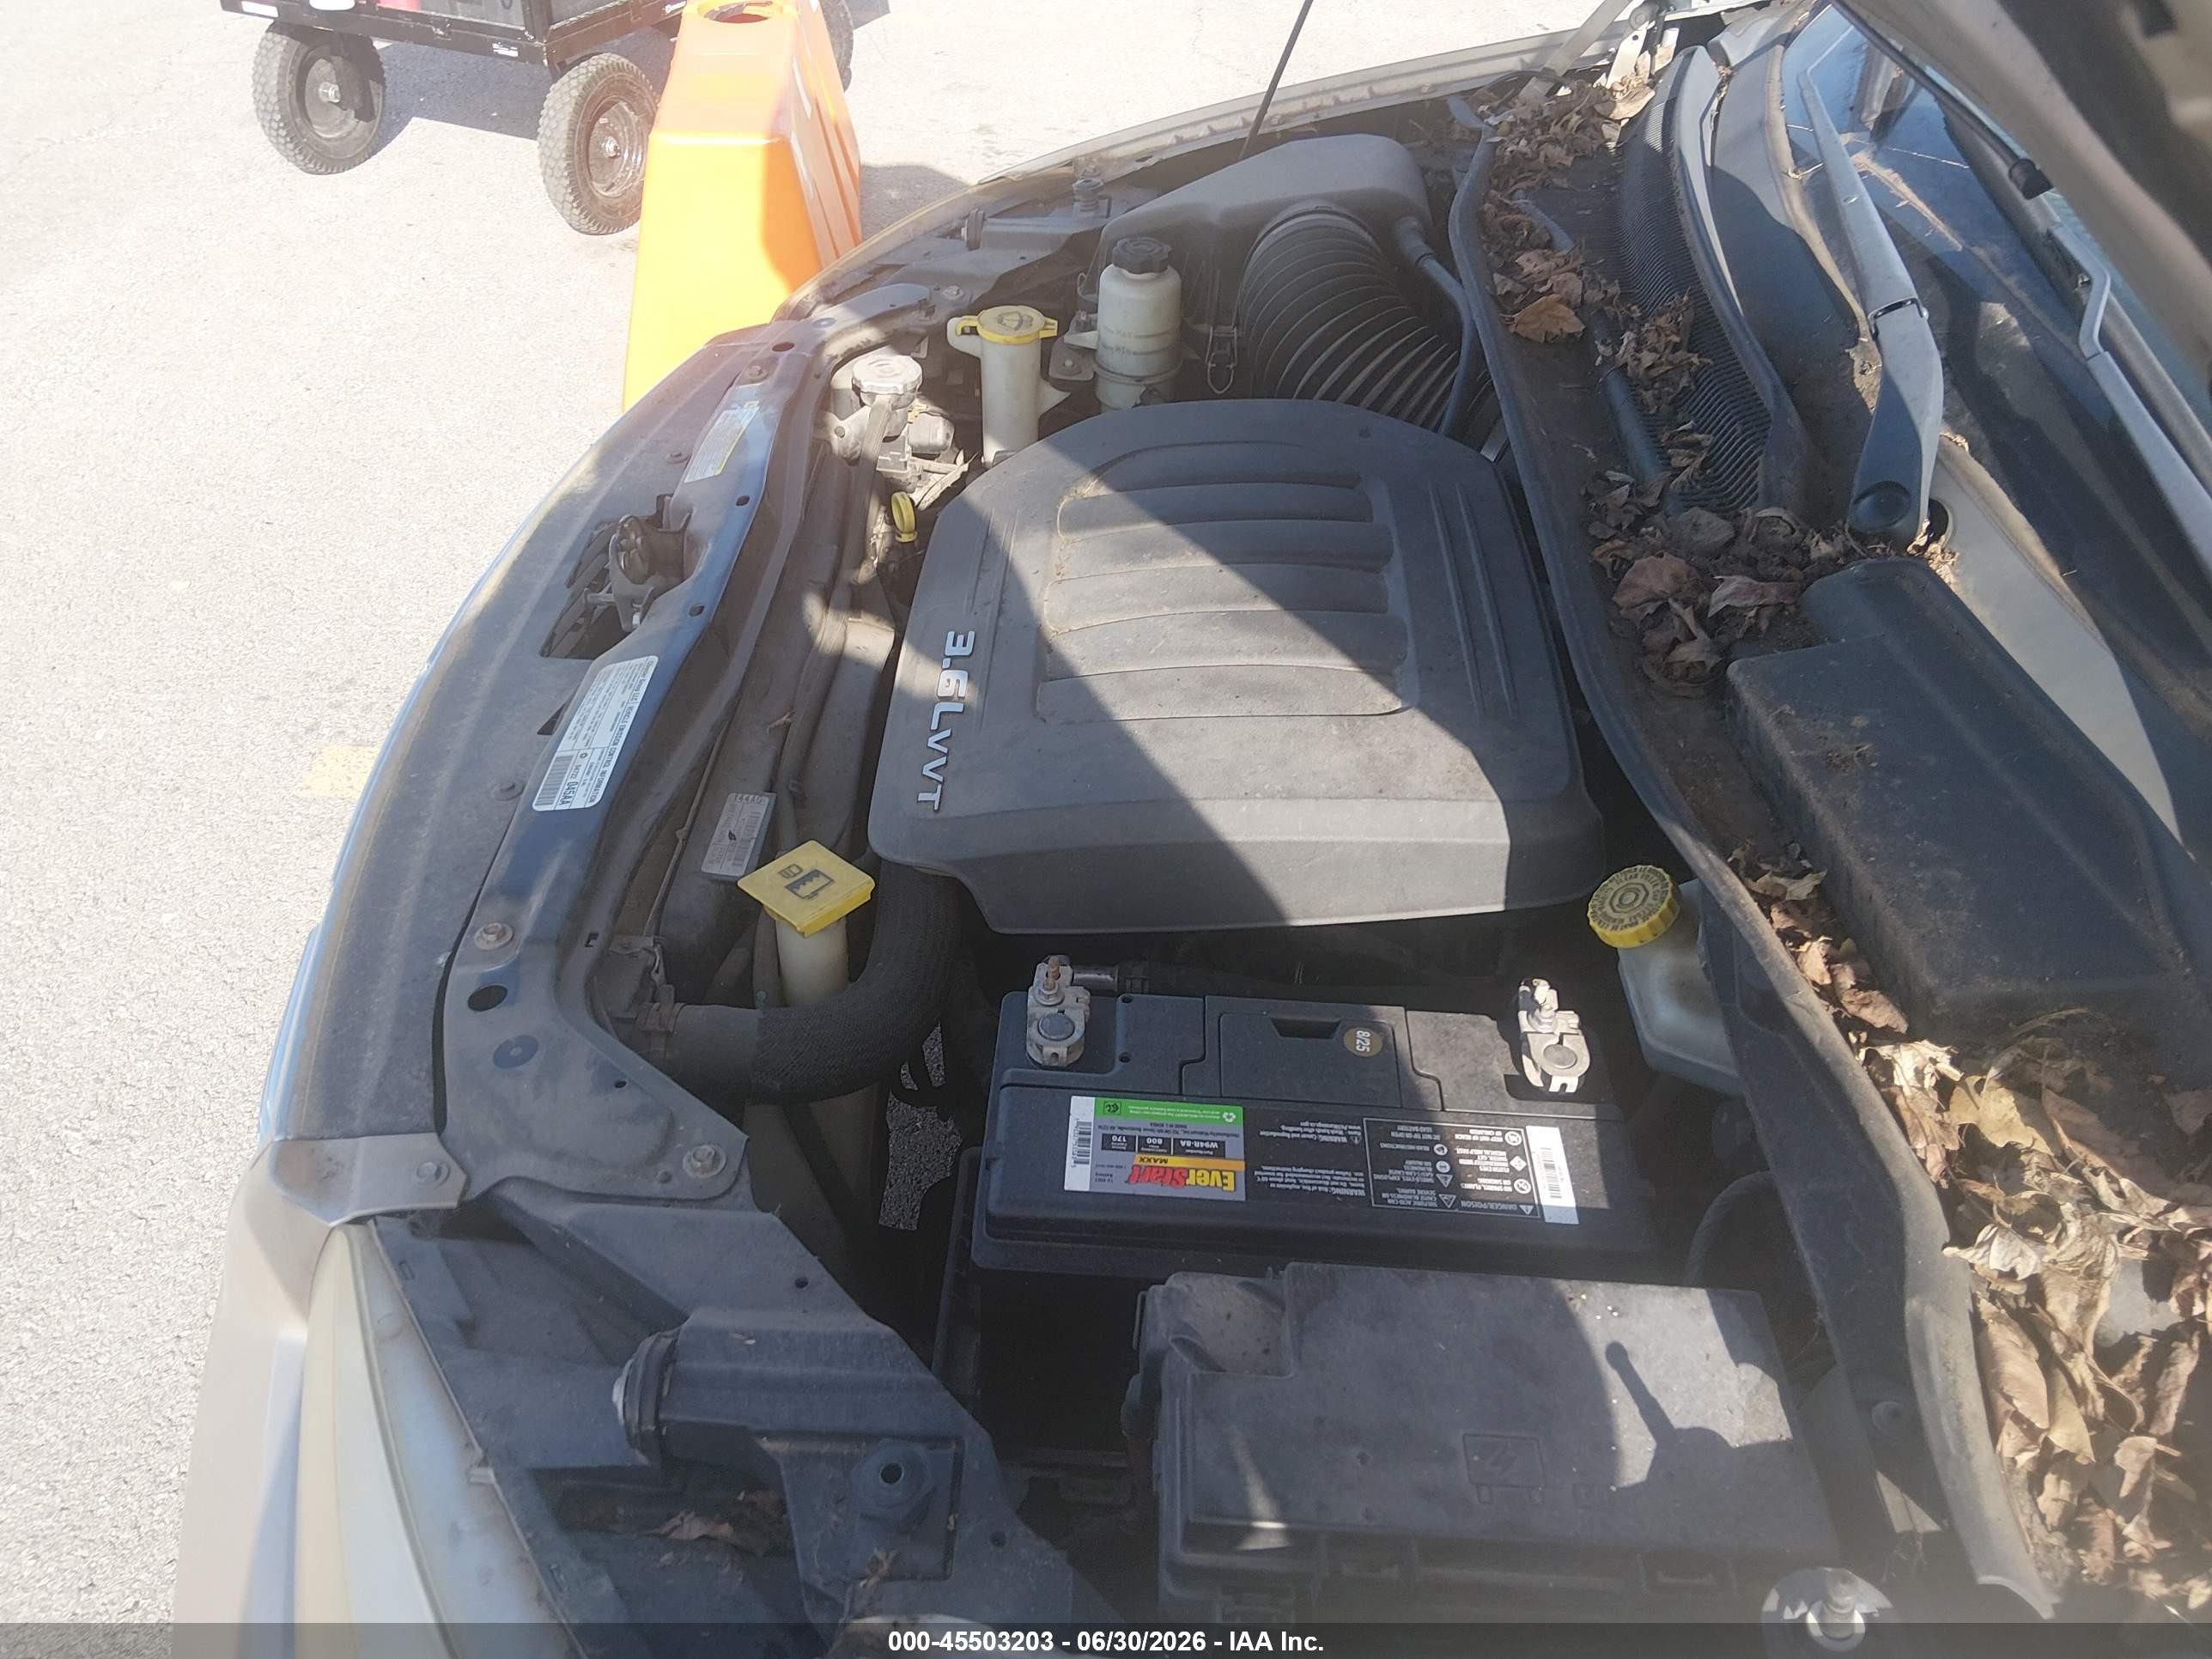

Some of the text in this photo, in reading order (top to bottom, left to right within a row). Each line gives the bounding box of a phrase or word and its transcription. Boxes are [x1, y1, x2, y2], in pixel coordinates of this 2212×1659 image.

[1356, 1030, 1370, 1052] 8/25
[1128, 1165, 1236, 1193] EverStart
[1328, 1188, 1366, 1196] WARNING:
[1461, 1200, 1518, 1210] DANGER/POISON
